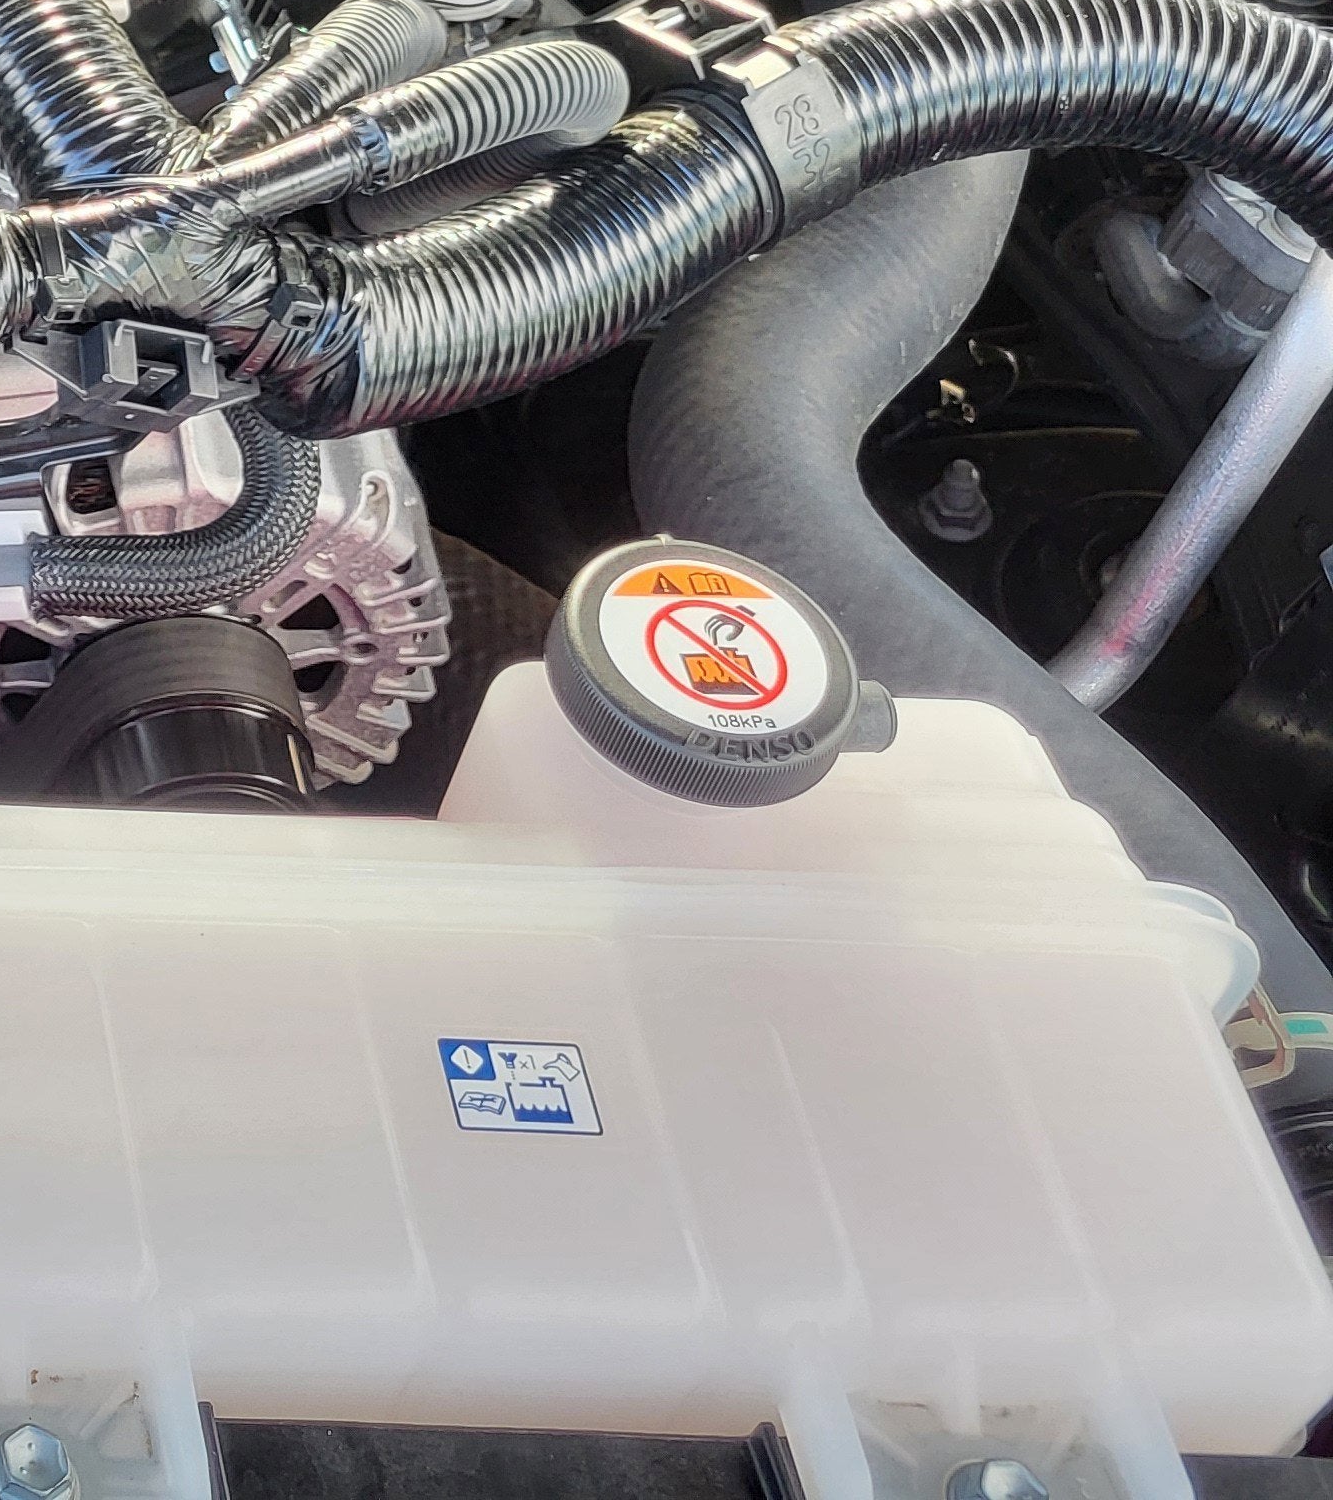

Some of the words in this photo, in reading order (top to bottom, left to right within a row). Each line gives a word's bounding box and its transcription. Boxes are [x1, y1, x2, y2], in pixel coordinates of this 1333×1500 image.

[774, 93, 820, 150] 28
[792, 136, 843, 191] 32
[707, 713, 777, 729] 108kPa
[683, 726, 817, 764] DENSO
